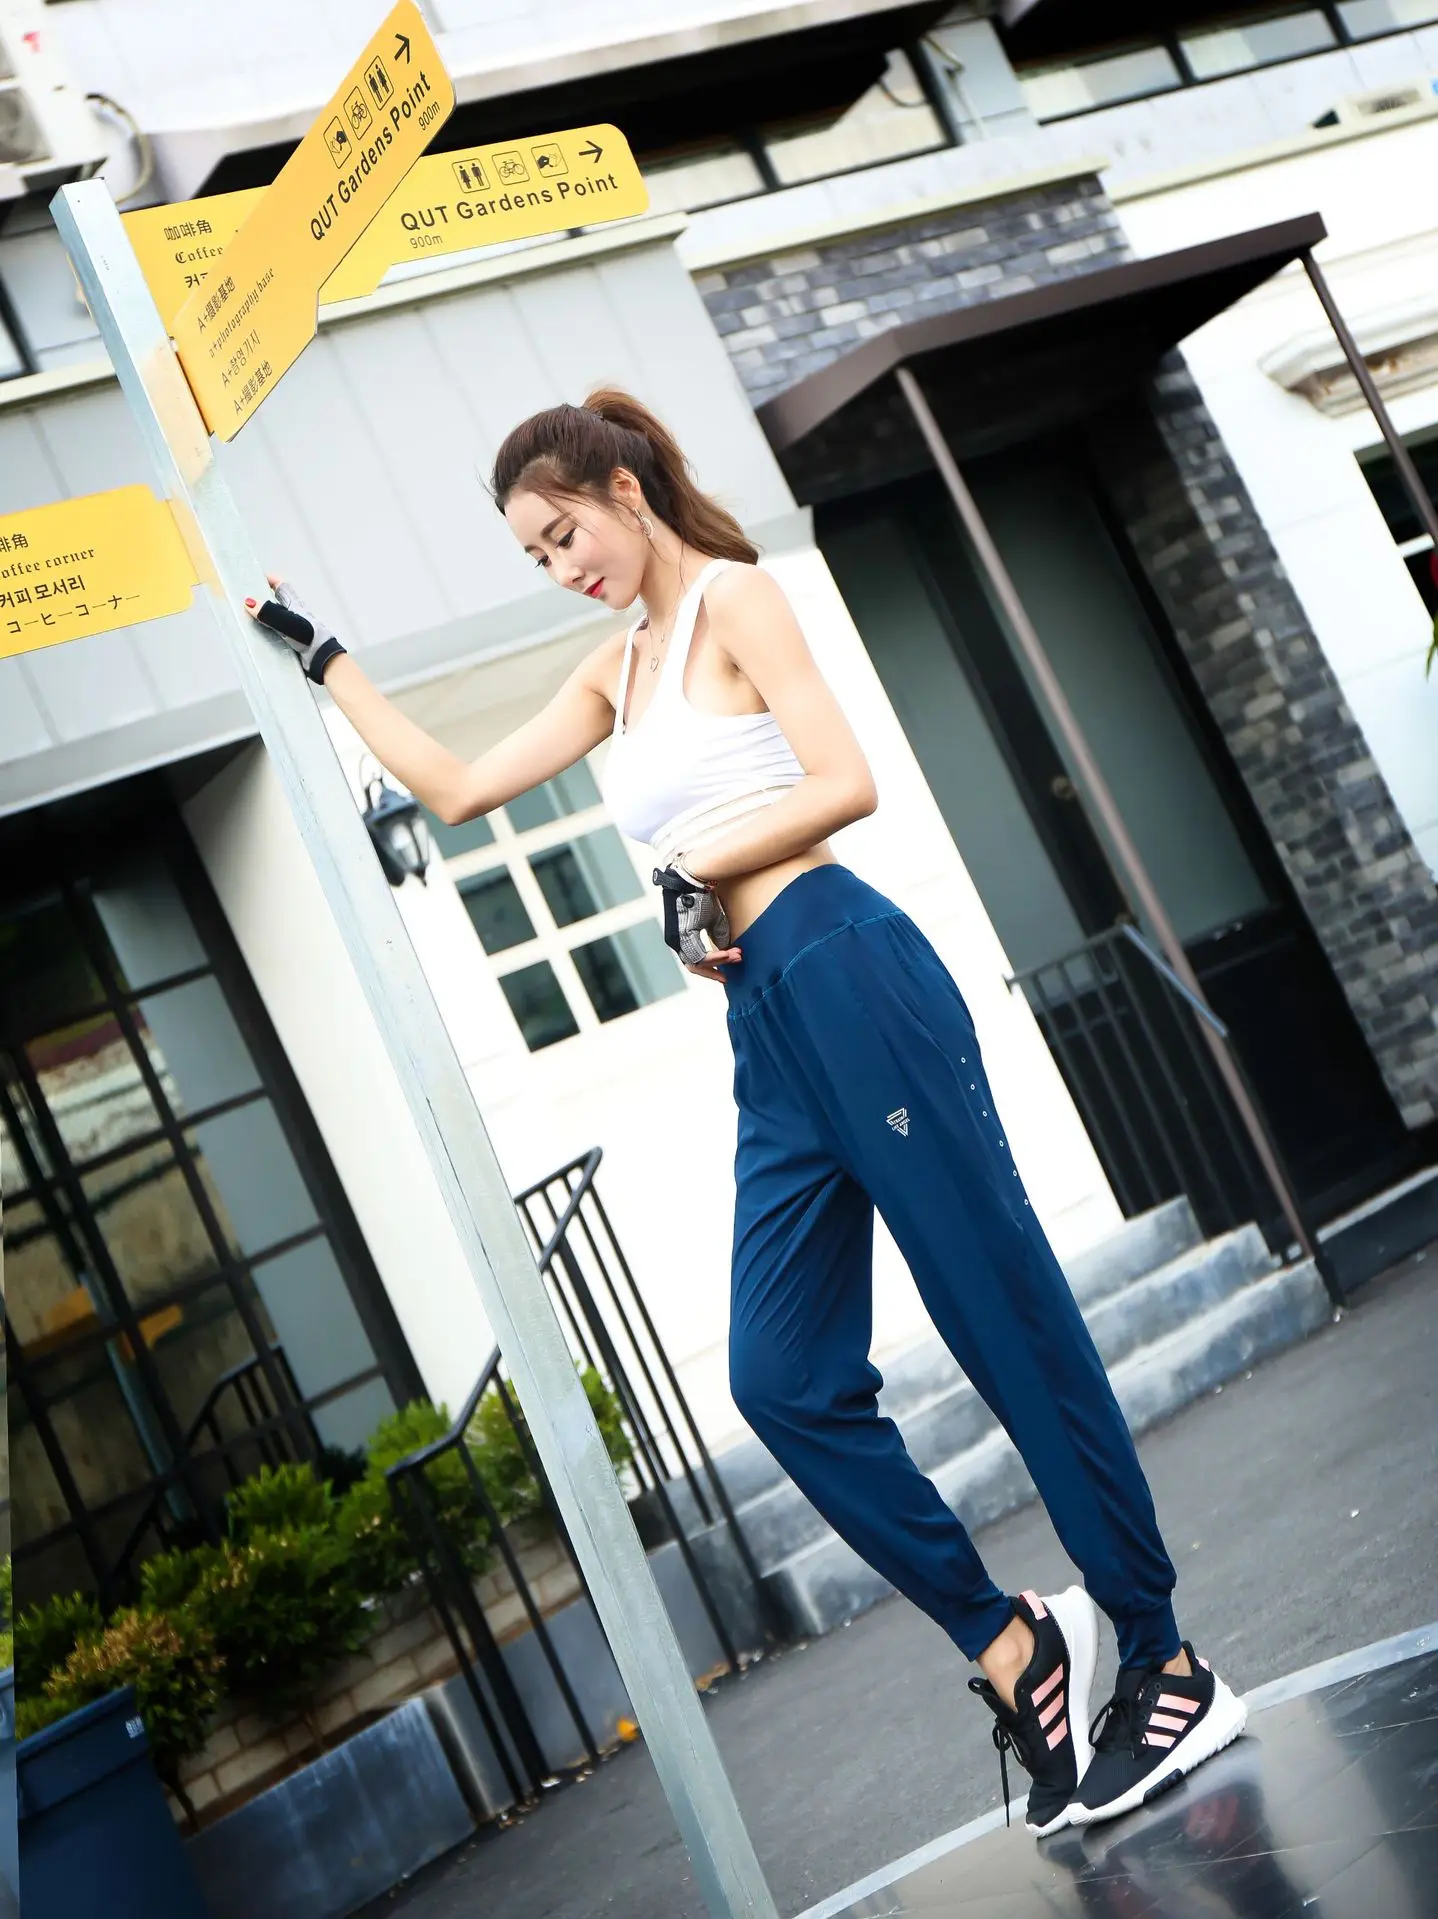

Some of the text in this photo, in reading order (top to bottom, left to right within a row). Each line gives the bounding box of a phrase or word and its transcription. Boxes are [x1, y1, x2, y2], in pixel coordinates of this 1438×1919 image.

[418, 101, 441, 131] 900m
[310, 70, 431, 241] QUT Gardens Point
[400, 173, 618, 231] QUT Gardens Point
[164, 219, 213, 241] 咖啡角
[409, 234, 444, 249] 900m
[184, 272, 209, 289] 커
[256, 268, 274, 292] base
[45, 548, 95, 568] corner
[0, 575, 86, 608] 커피 모서리
